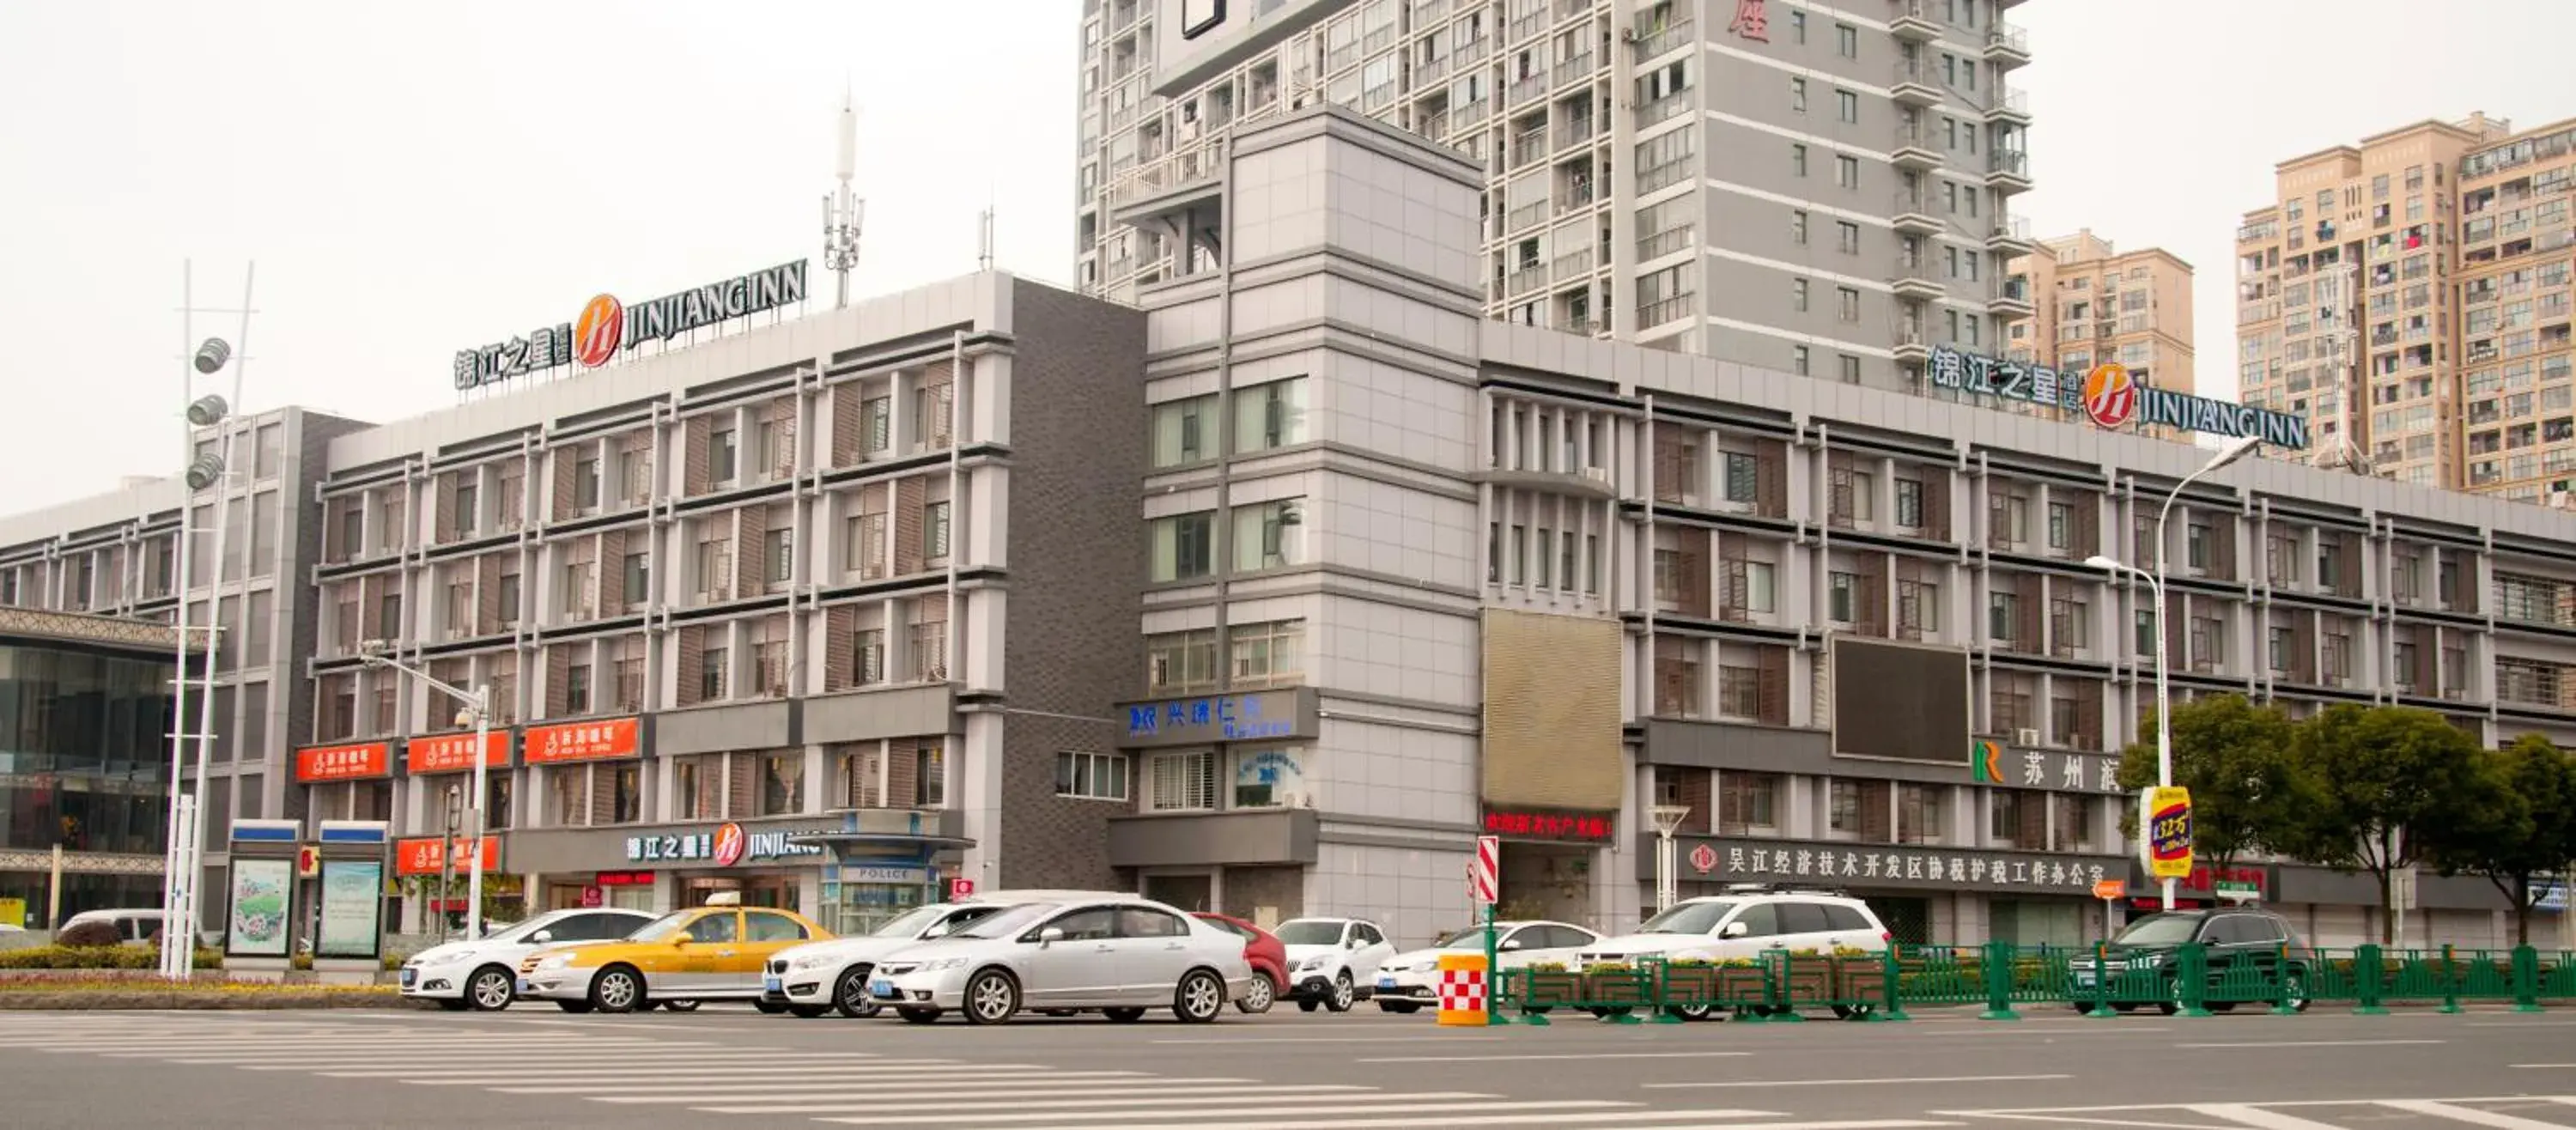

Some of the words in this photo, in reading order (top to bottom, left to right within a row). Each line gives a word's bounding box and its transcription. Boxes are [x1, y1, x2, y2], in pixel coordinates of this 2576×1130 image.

[624, 275, 748, 350] JINJIANG
[747, 258, 807, 313] INN
[454, 329, 555, 390] 锦江之星
[1931, 346, 2059, 405] 锦江之星
[2137, 388, 2257, 438] JINJIANG
[2258, 408, 2305, 449] INN
[860, 868, 908, 879] POLICE
